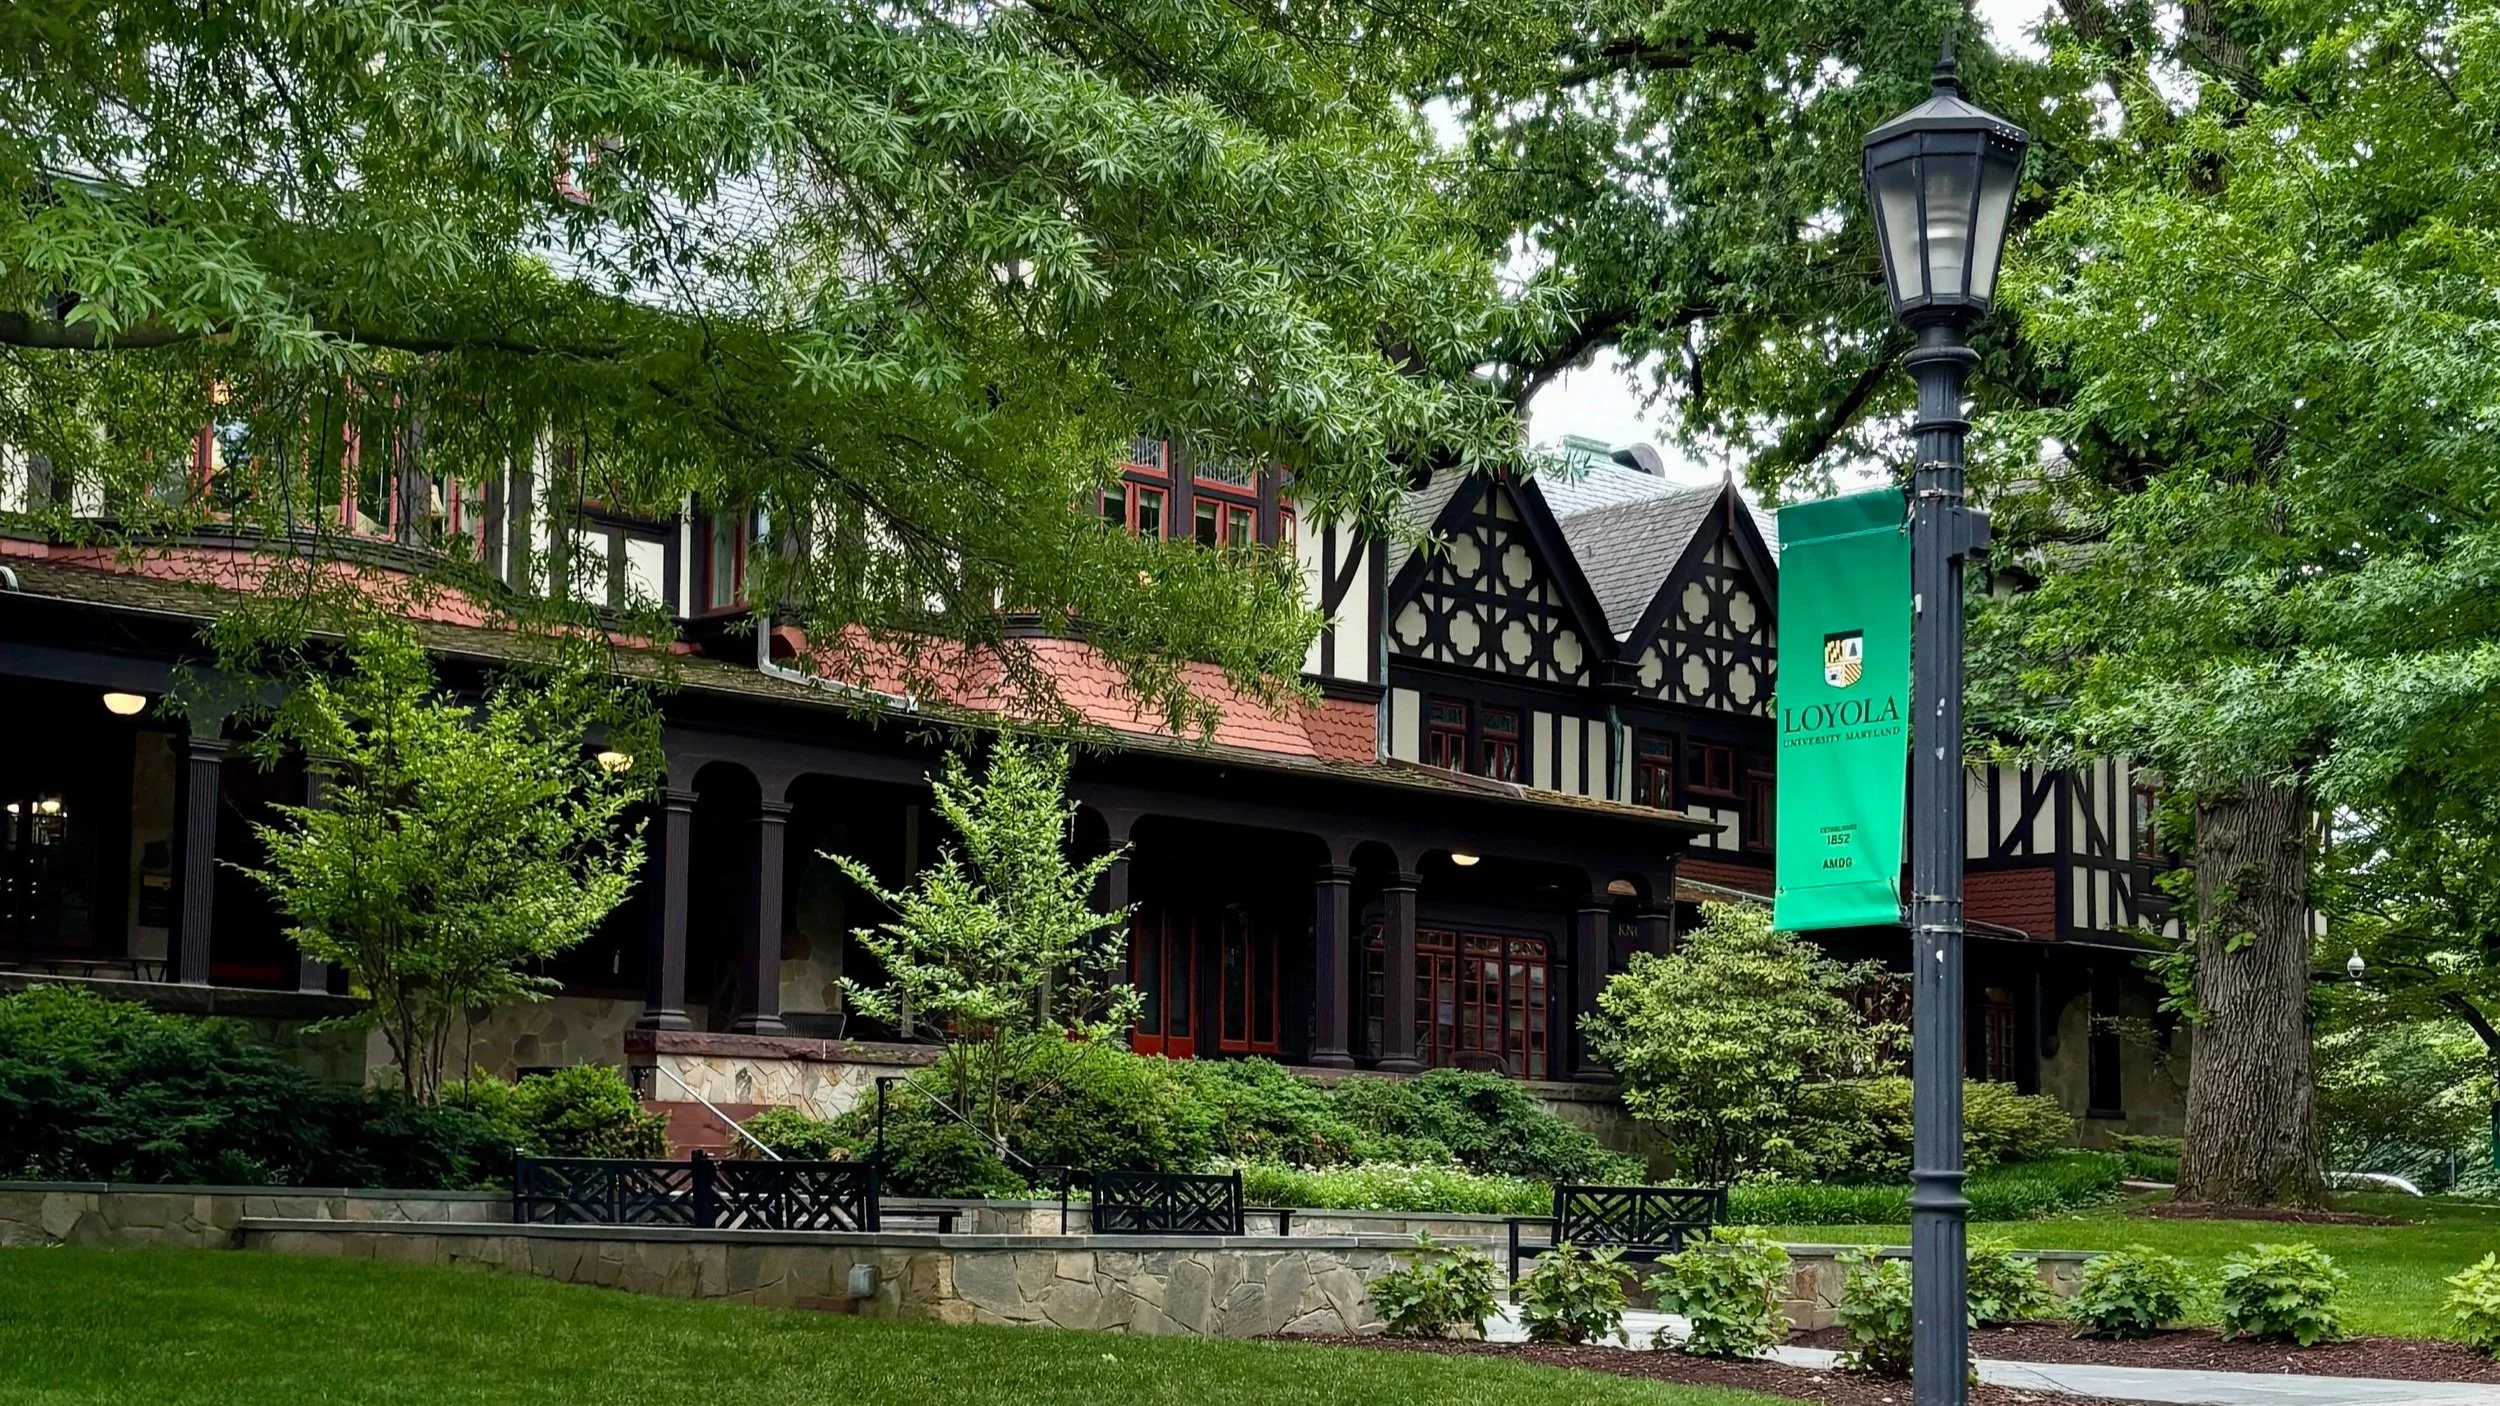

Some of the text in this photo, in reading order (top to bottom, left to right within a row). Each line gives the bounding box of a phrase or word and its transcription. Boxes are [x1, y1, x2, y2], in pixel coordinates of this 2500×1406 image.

[1784, 695, 1900, 733] LOYOLA
[1783, 727, 1900, 748] UNIVERSITY MARYLAND
[1827, 833, 1850, 845] 1852
[1822, 857, 1852, 869] AMDG
